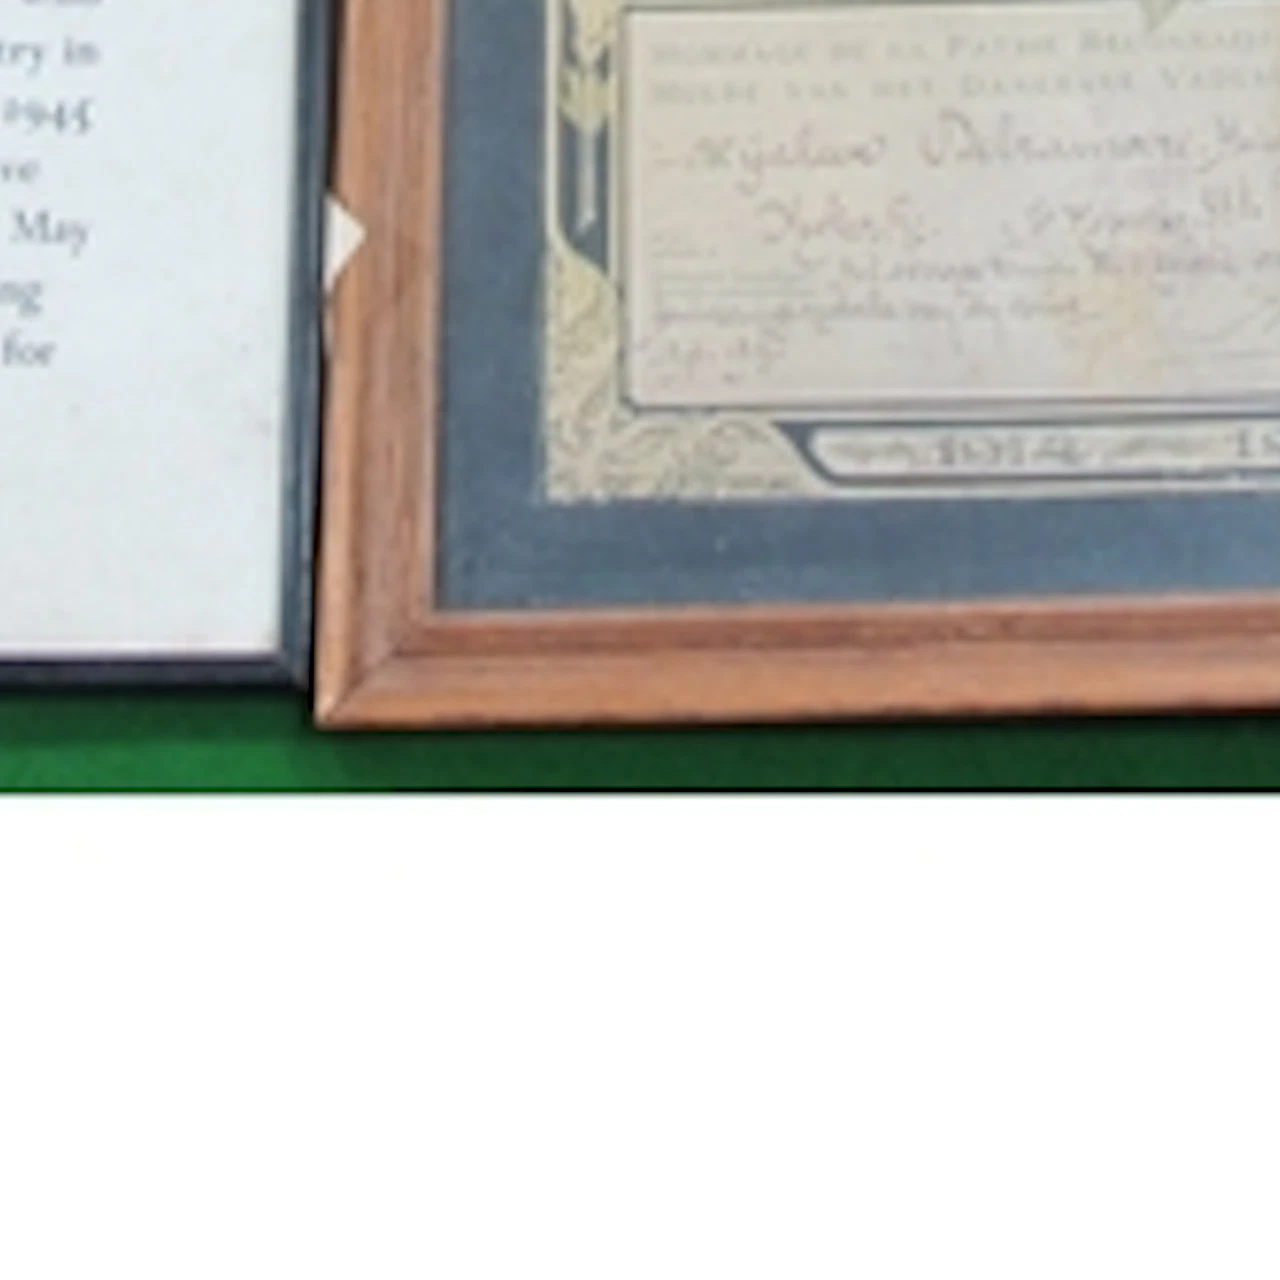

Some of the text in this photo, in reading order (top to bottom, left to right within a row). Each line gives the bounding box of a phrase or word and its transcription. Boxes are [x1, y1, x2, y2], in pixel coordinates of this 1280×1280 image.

[62, 36, 101, 66] in
[13, 209, 88, 257] May
[1, 330, 56, 367] for
